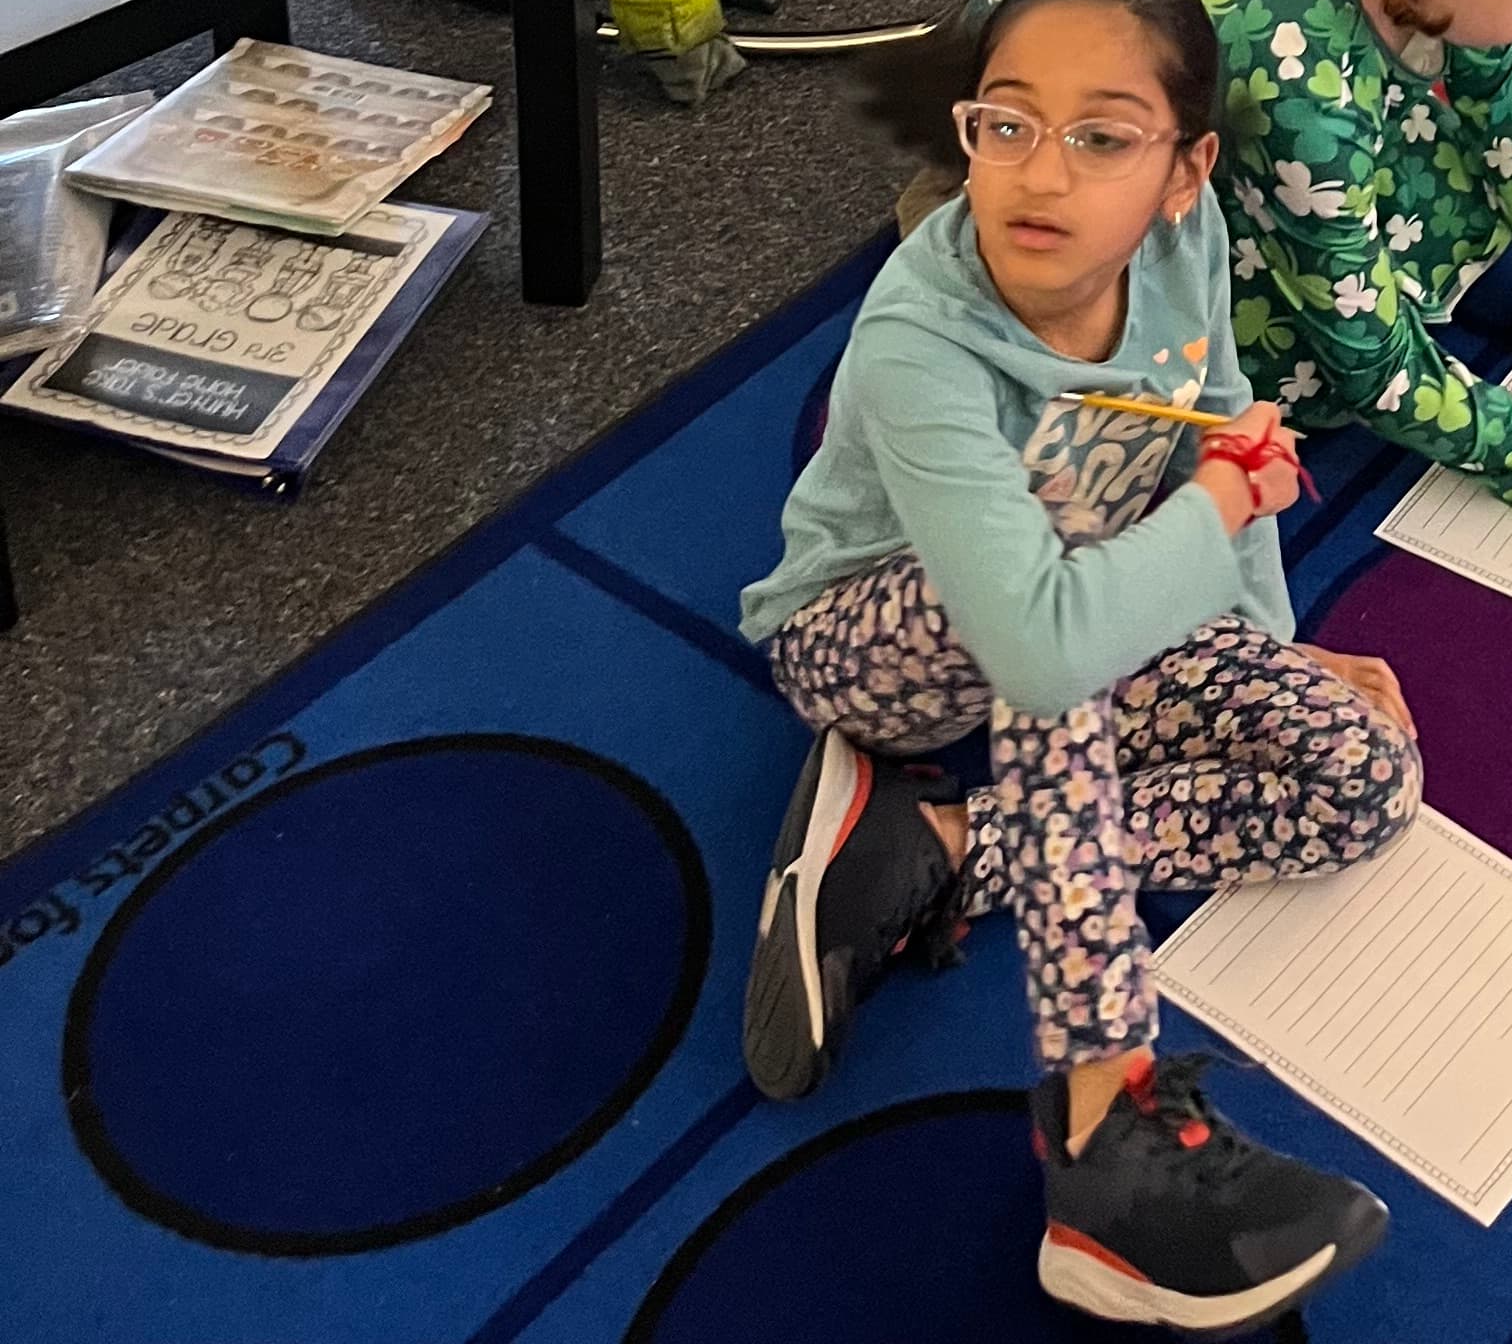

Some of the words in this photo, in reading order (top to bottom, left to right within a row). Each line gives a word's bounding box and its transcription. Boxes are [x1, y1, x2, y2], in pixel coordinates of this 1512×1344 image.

[130, 312, 239, 353] Grade
[243, 341, 296, 363] 3rd
[79, 730, 307, 897] Carpets
